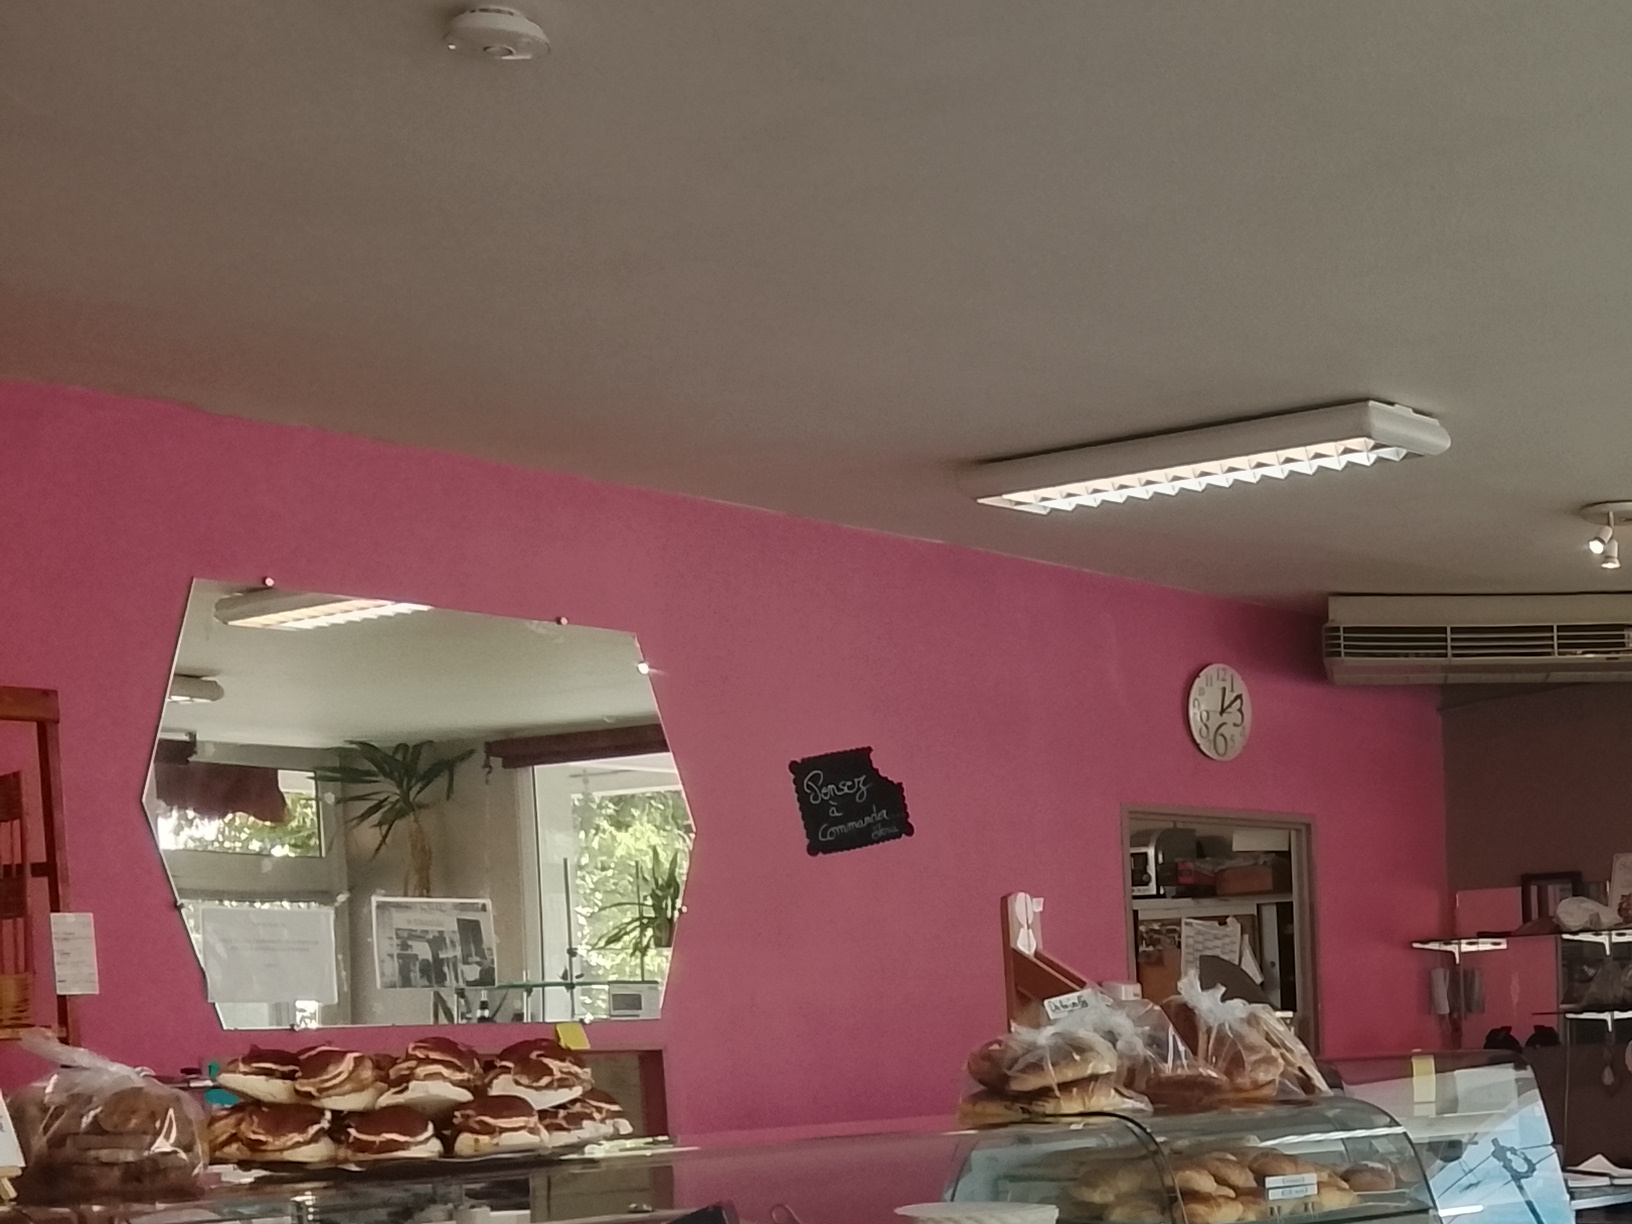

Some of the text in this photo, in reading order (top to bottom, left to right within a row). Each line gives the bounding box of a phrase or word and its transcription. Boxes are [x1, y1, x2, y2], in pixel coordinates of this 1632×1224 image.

[1216, 667, 1227, 682] 12
[1230, 673, 1235, 693] 1
[1199, 709, 1210, 739] 8
[1232, 693, 1245, 728] 3
[1213, 721, 1228, 757] 6
[803, 770, 871, 804] Pensez
[829, 801, 844, 817] à
